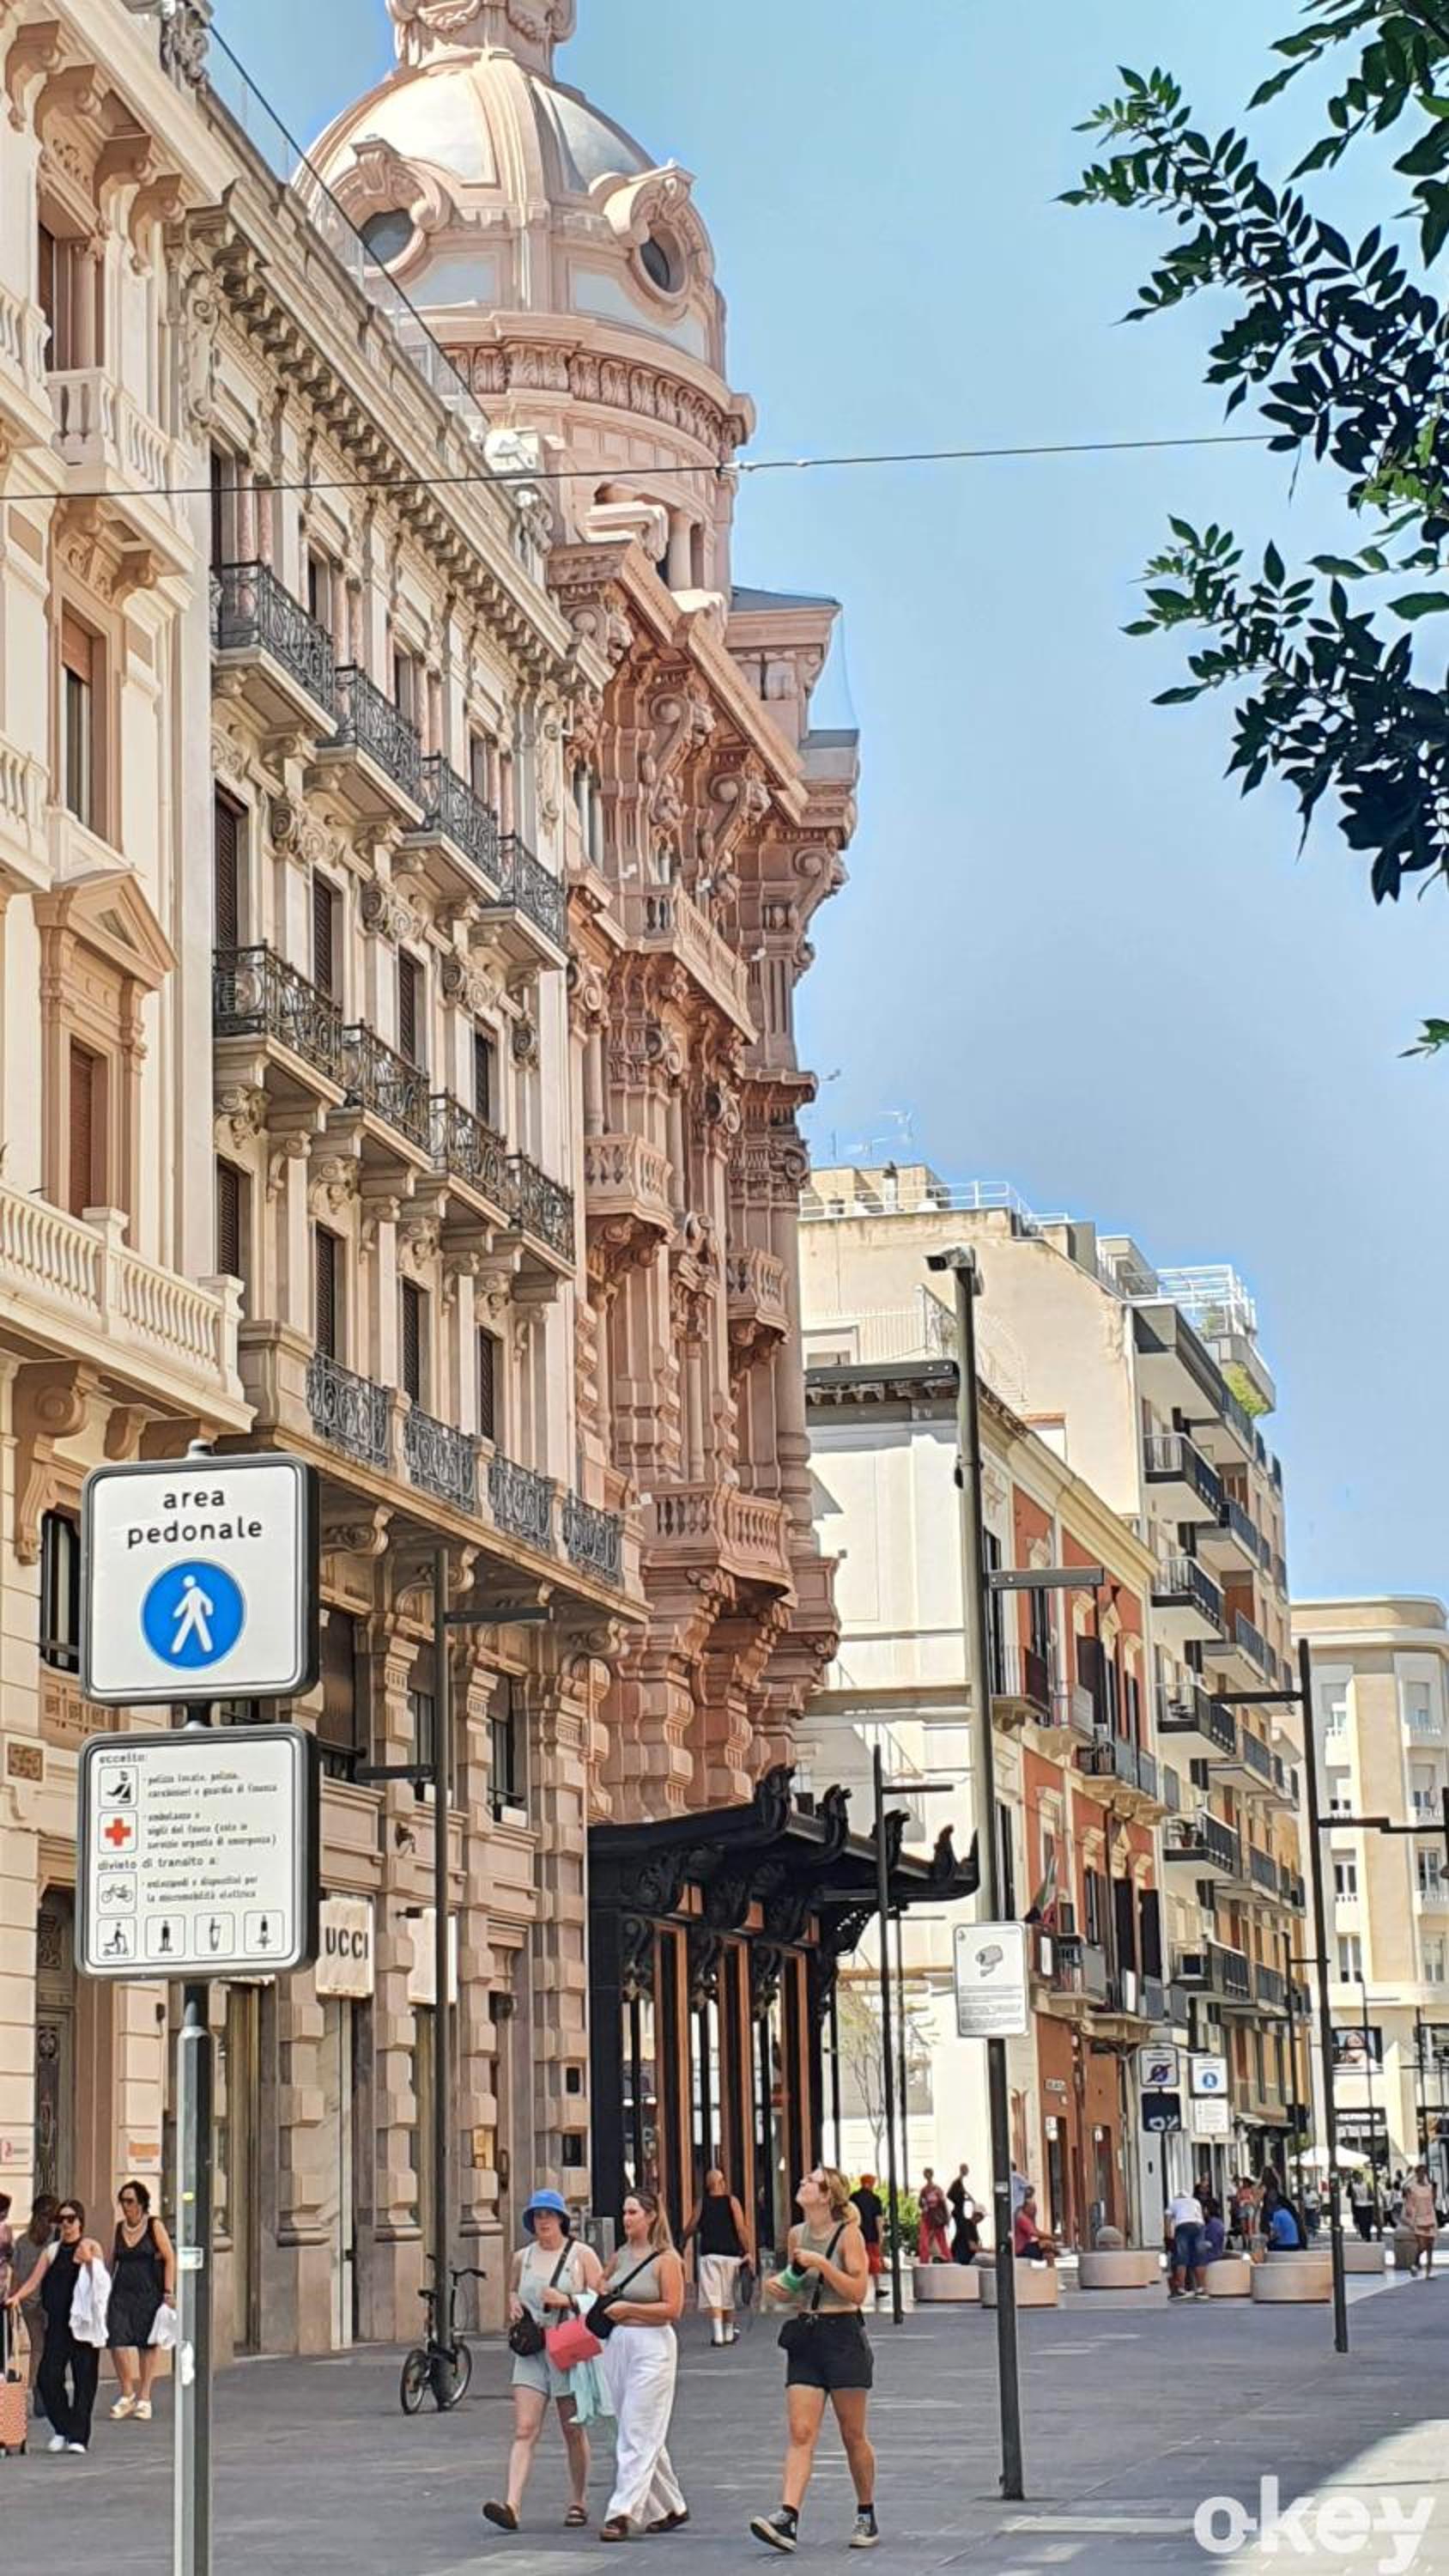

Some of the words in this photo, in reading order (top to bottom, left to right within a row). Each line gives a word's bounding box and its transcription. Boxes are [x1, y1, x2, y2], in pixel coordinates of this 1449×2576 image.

[163, 1490, 225, 1509] area
[128, 1516, 263, 1549] pedonale
[142, 1857, 153, 1868] di
[158, 1856, 204, 1868] transito
